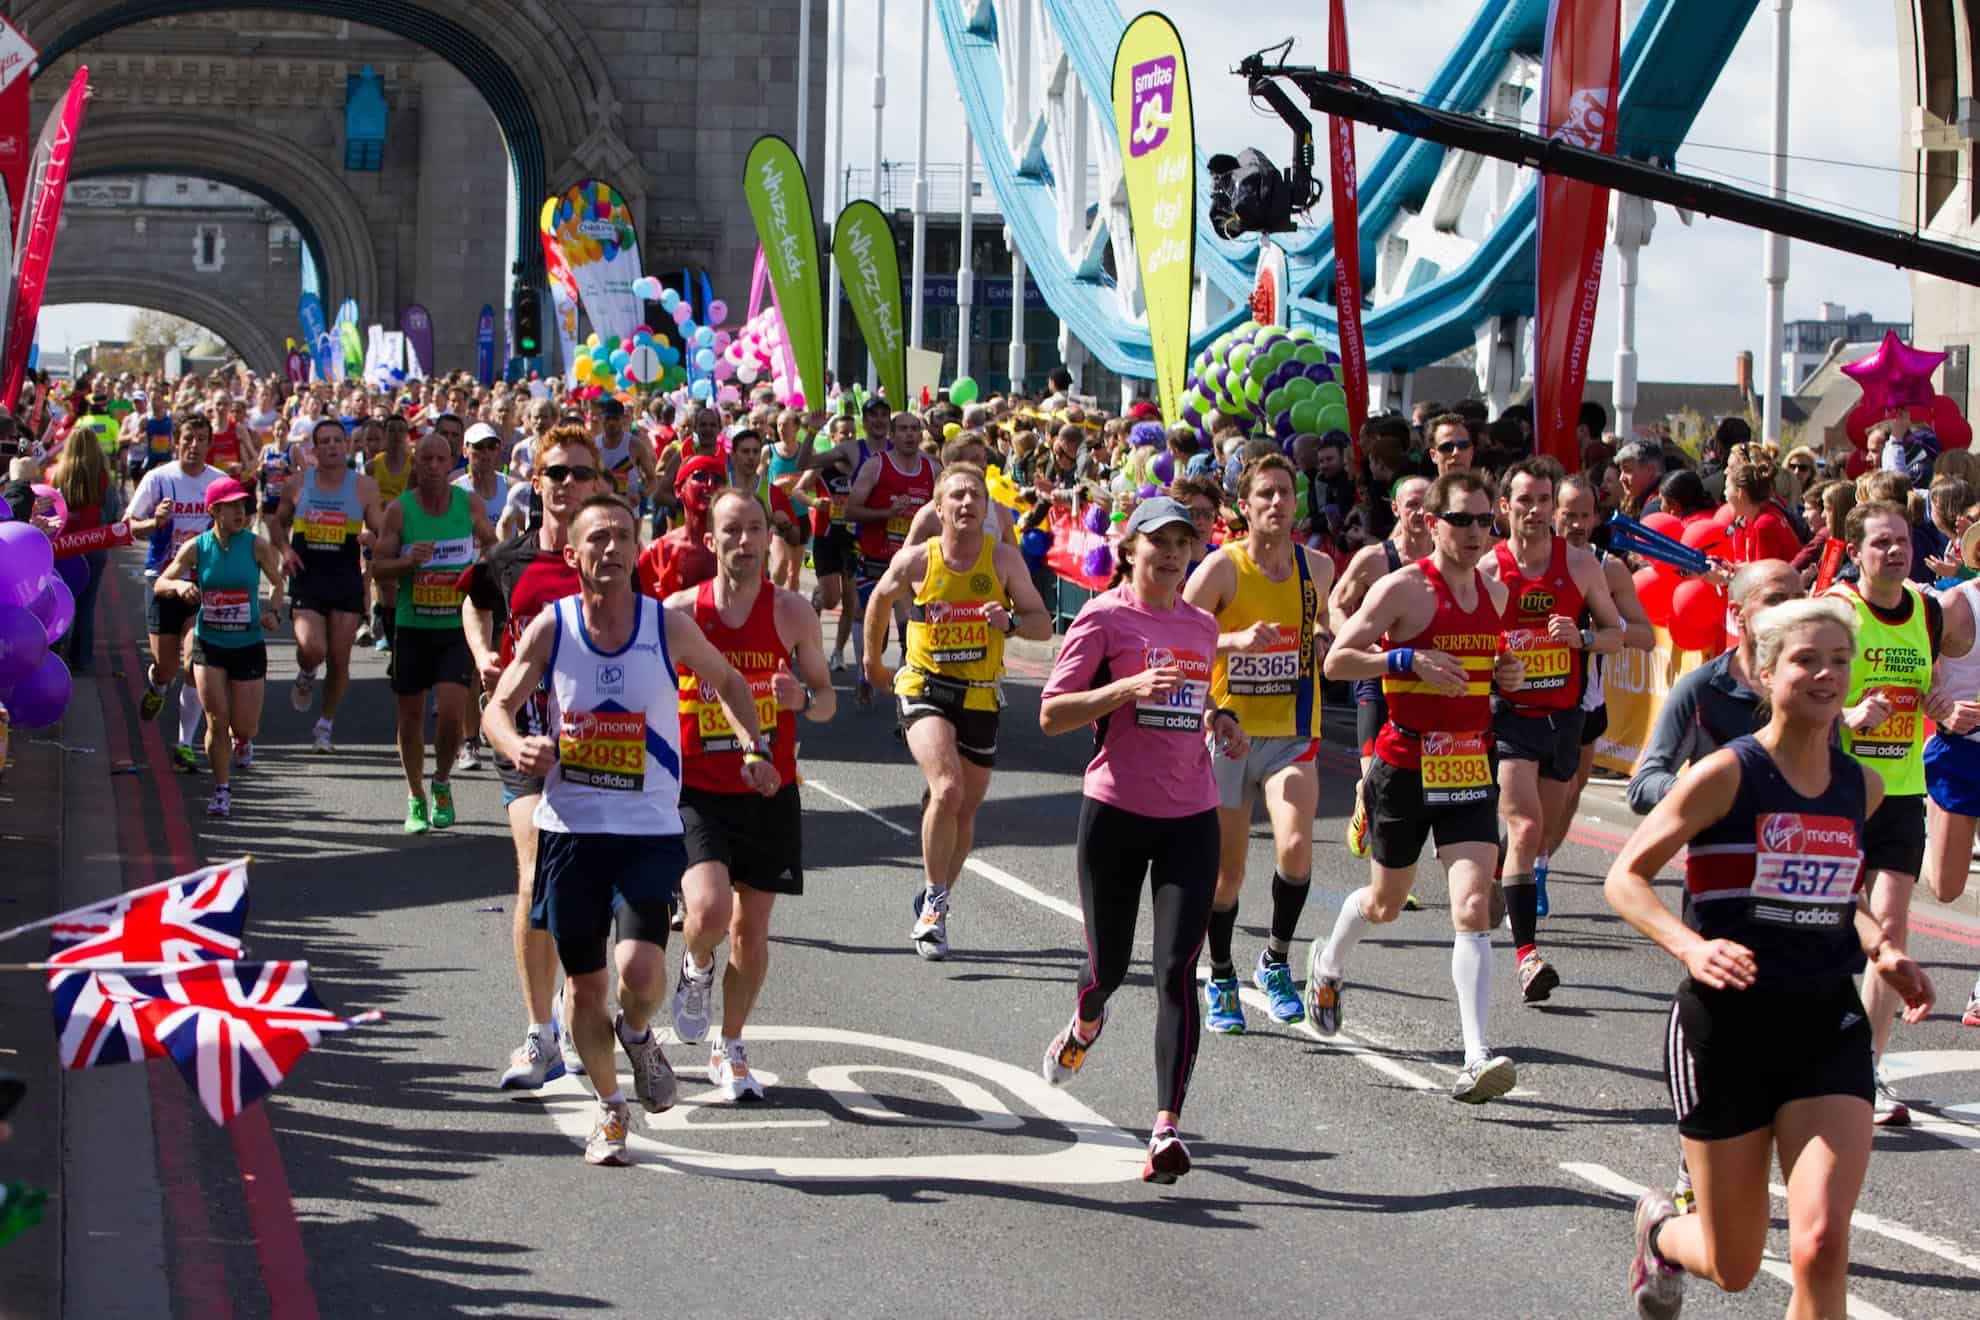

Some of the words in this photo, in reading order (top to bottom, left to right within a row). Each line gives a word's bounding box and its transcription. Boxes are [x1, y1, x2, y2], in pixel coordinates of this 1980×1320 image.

[59, 528, 107, 551] Money
[929, 624, 987, 647] 32344
[1432, 634, 1499, 651] SERPENTIN
[1884, 647, 1918, 657] CYSTIC
[1176, 659, 1209, 673] money
[1230, 655, 1297, 677] 25365
[1517, 652, 1568, 674] 2910
[1885, 656, 1926, 666] FIBROSIS
[1885, 664, 1915, 673] TRUST
[1533, 678, 1565, 690] adidas
[599, 721, 642, 734] money
[562, 743, 643, 769] 32993
[1423, 759, 1488, 784] 33393
[591, 773, 635, 788] adidas
[1450, 788, 1487, 802] adidas
[1807, 829, 1855, 848] money
[1778, 860, 1840, 896] 537
[1794, 907, 1840, 924] adidas
